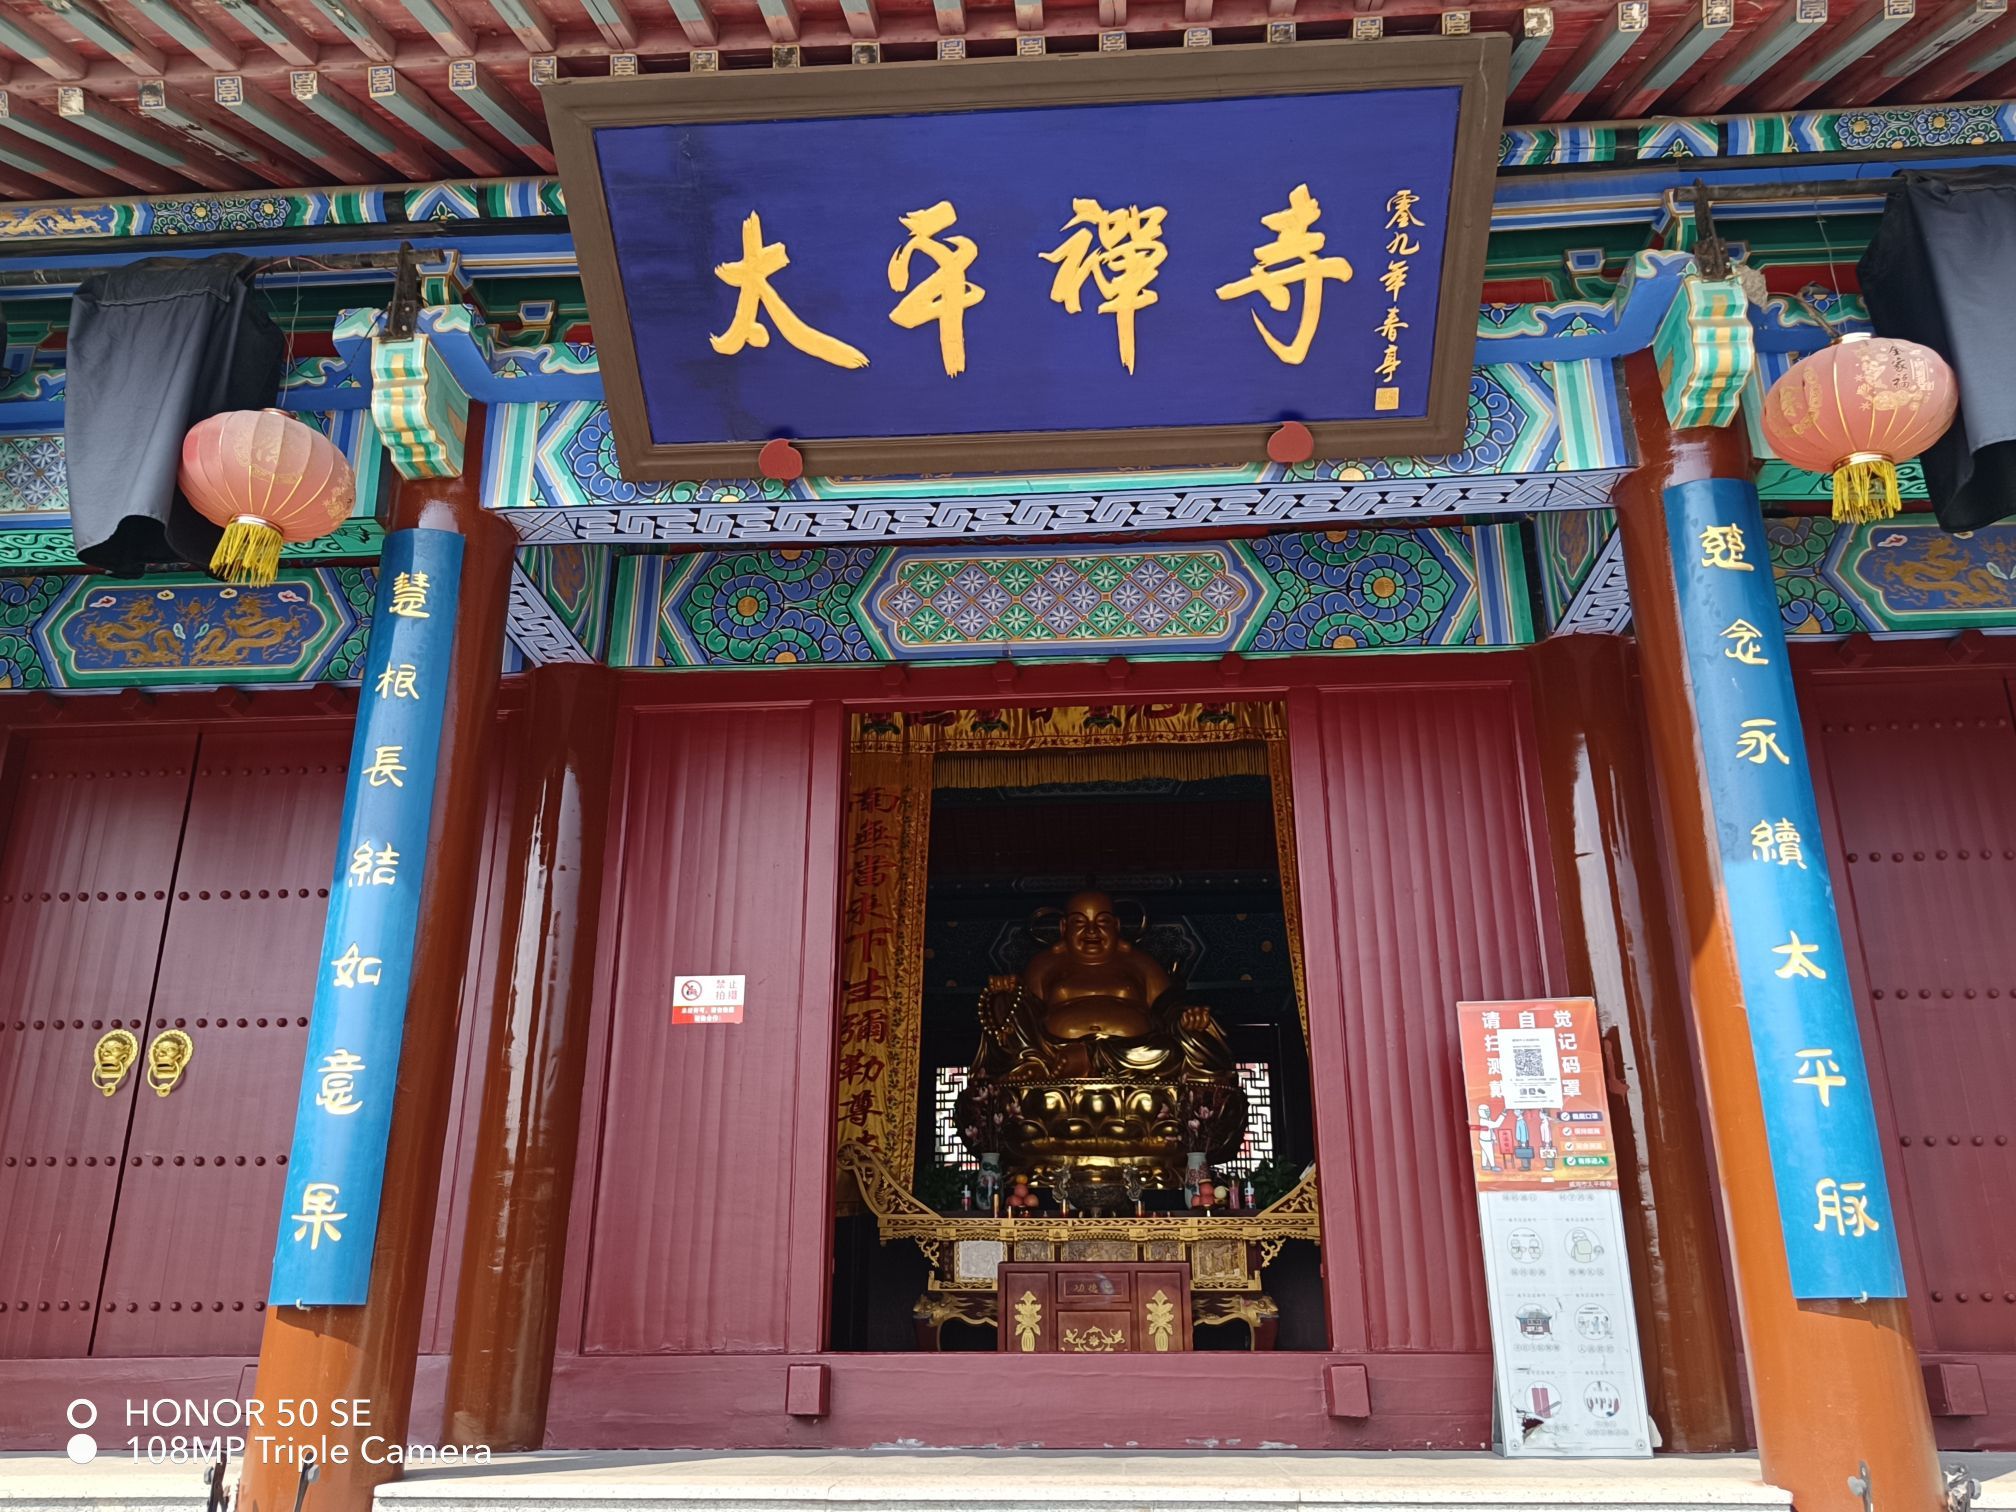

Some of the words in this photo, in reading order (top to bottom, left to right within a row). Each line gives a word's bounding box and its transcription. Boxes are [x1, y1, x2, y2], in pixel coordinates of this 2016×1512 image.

[709, 183, 1353, 378] 太平禪寺
[1482, 1010, 1573, 1029] 请自觉
